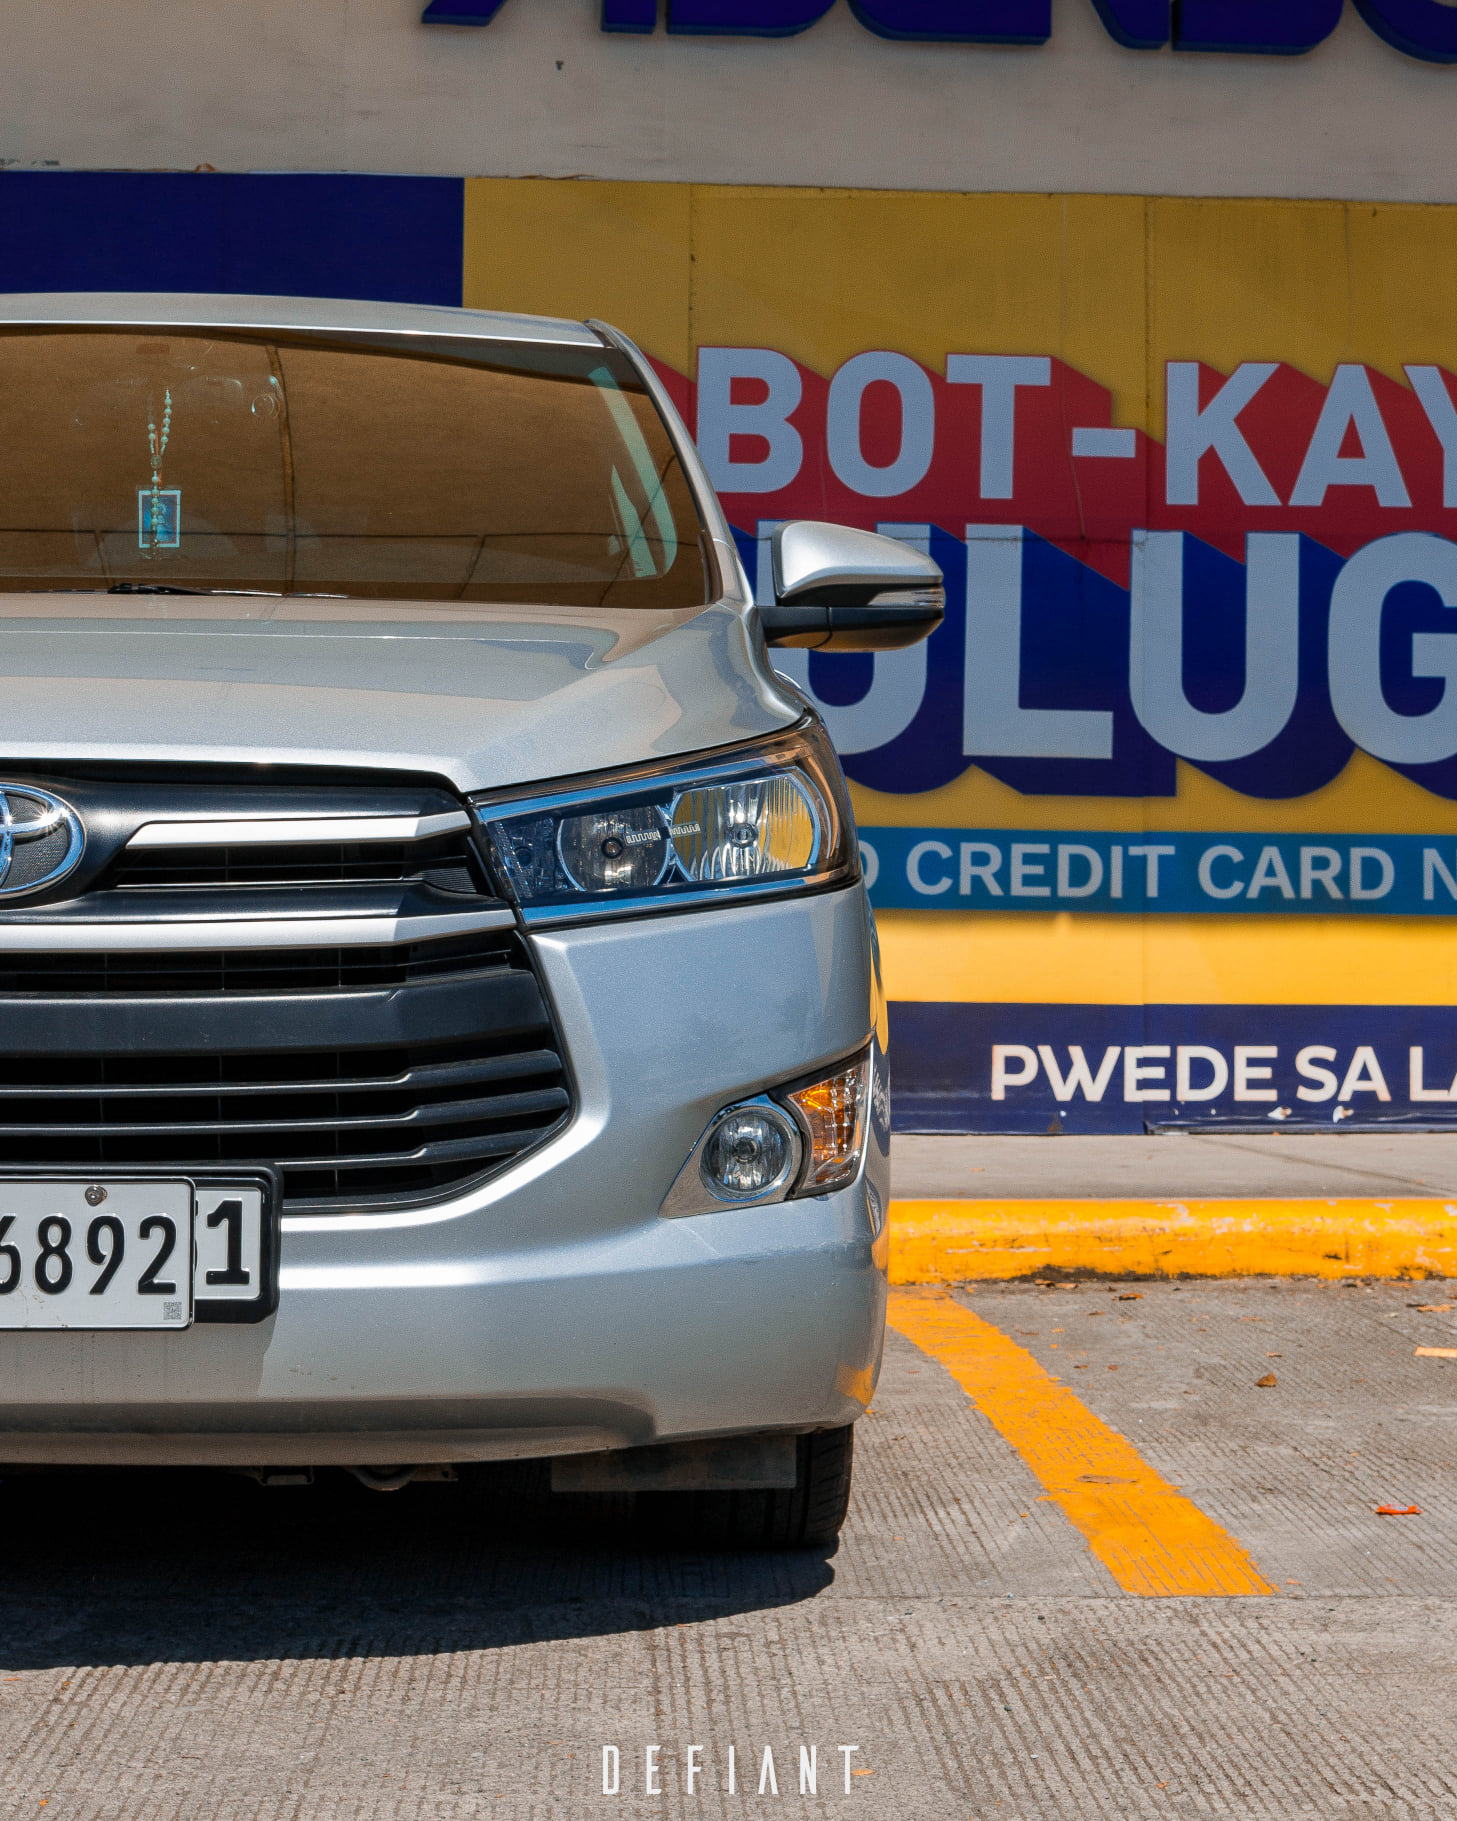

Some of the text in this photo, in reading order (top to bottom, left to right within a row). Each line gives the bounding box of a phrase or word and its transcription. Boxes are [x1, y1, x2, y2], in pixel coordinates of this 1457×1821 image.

[906, 840, 1175, 900] CREDIT
[1198, 845, 1395, 901] CARD
[991, 1044, 1457, 1102] PWEDE SA L
[0, 1214, 177, 1295] 6892
[195, 1199, 250, 1285] 1
